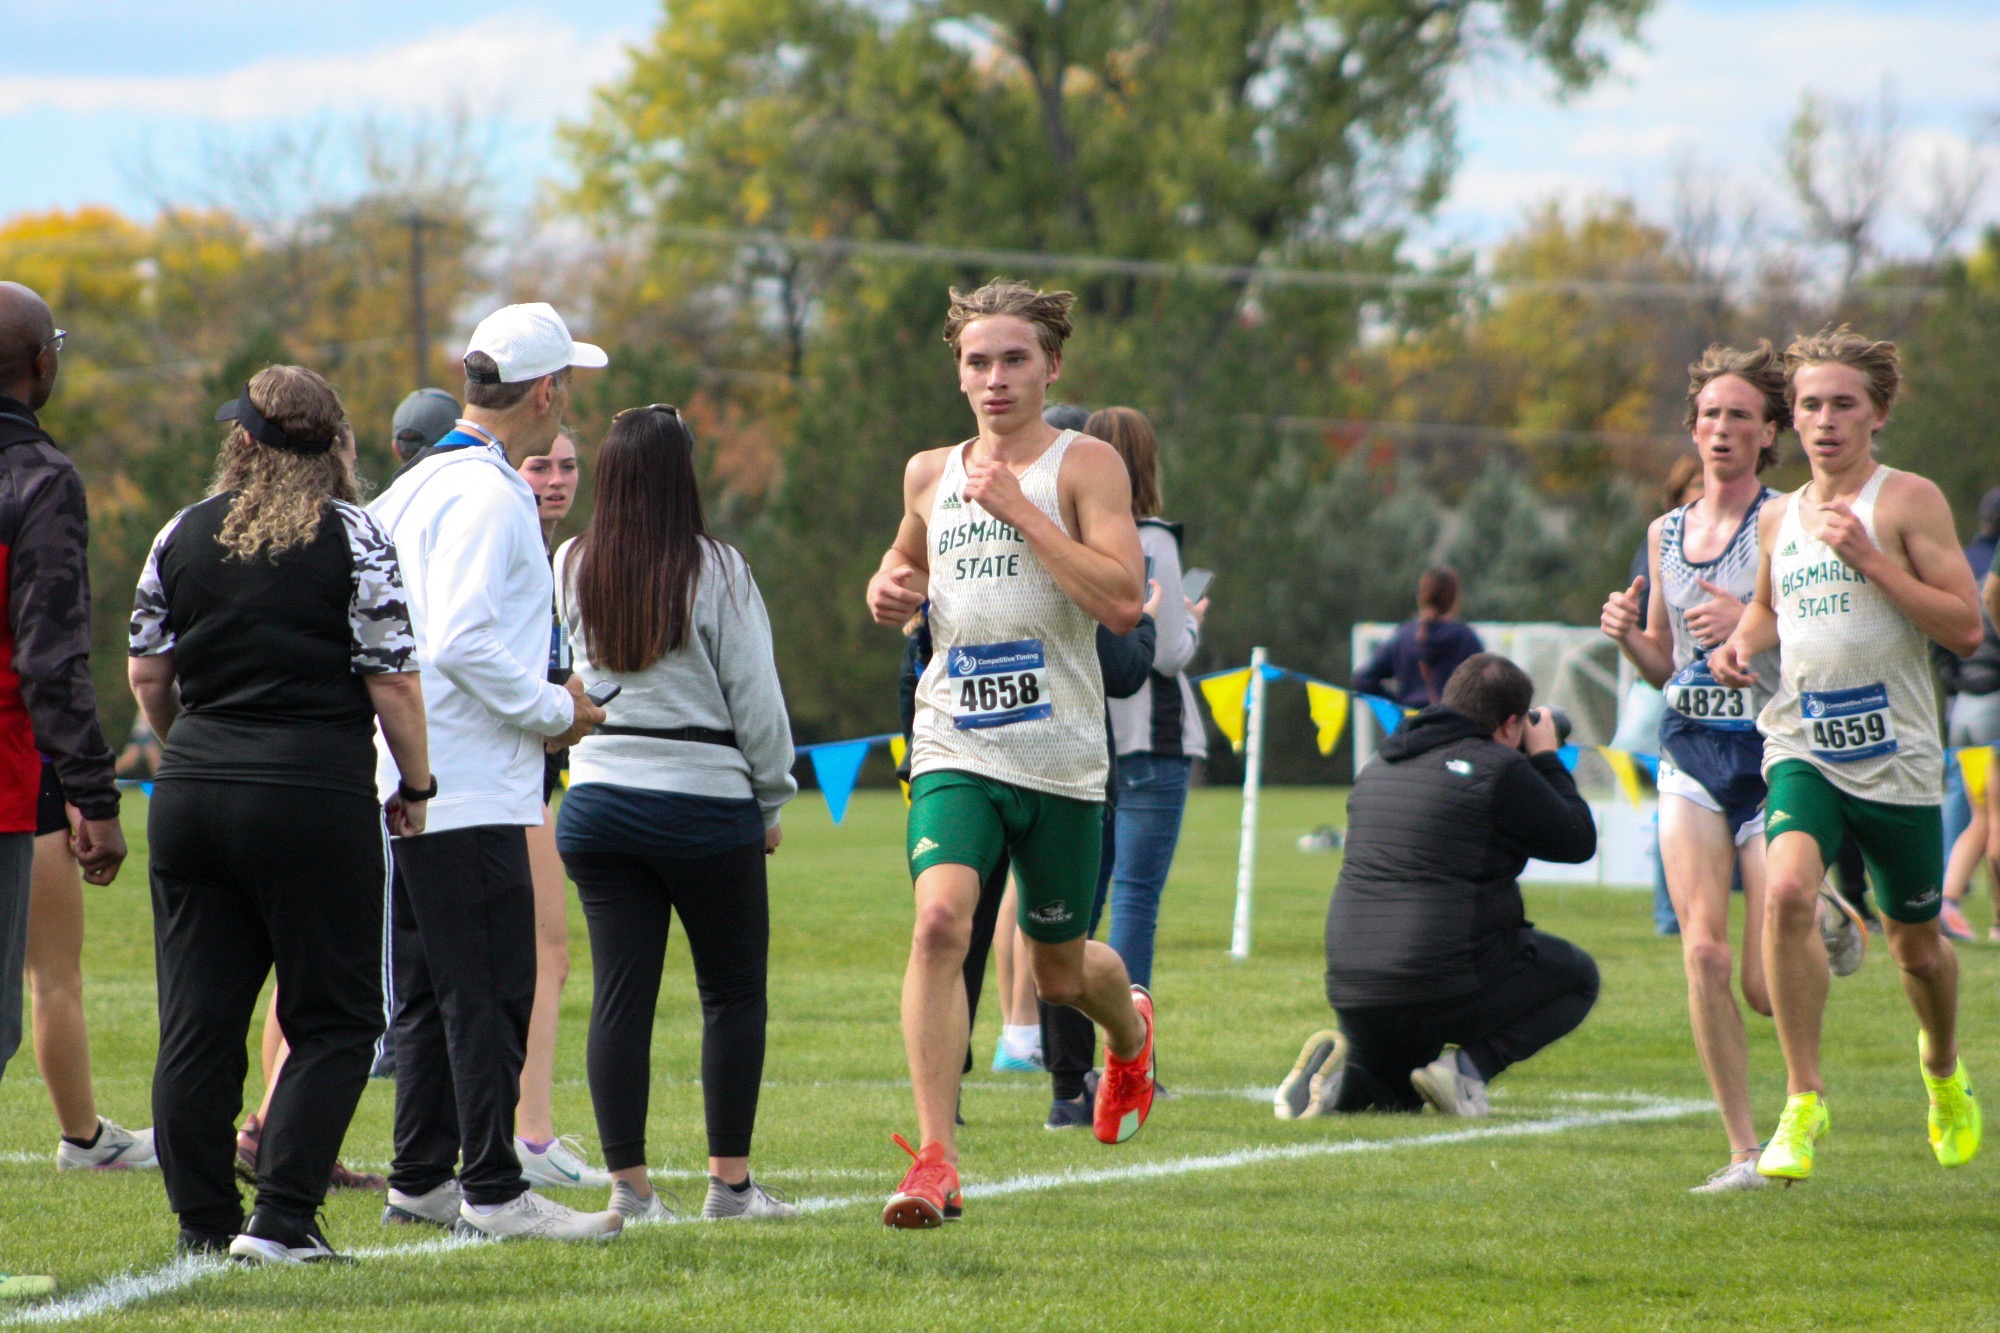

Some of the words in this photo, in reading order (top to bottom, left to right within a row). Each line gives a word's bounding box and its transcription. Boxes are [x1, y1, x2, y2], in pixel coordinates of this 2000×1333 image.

[938, 519, 1025, 556] BISMARC
[955, 553, 1020, 580] STATE
[1797, 591, 1851, 618] STATE
[960, 672, 1040, 712] 4658
[1675, 688, 1744, 717] 4823
[1812, 712, 1886, 749] 4659
